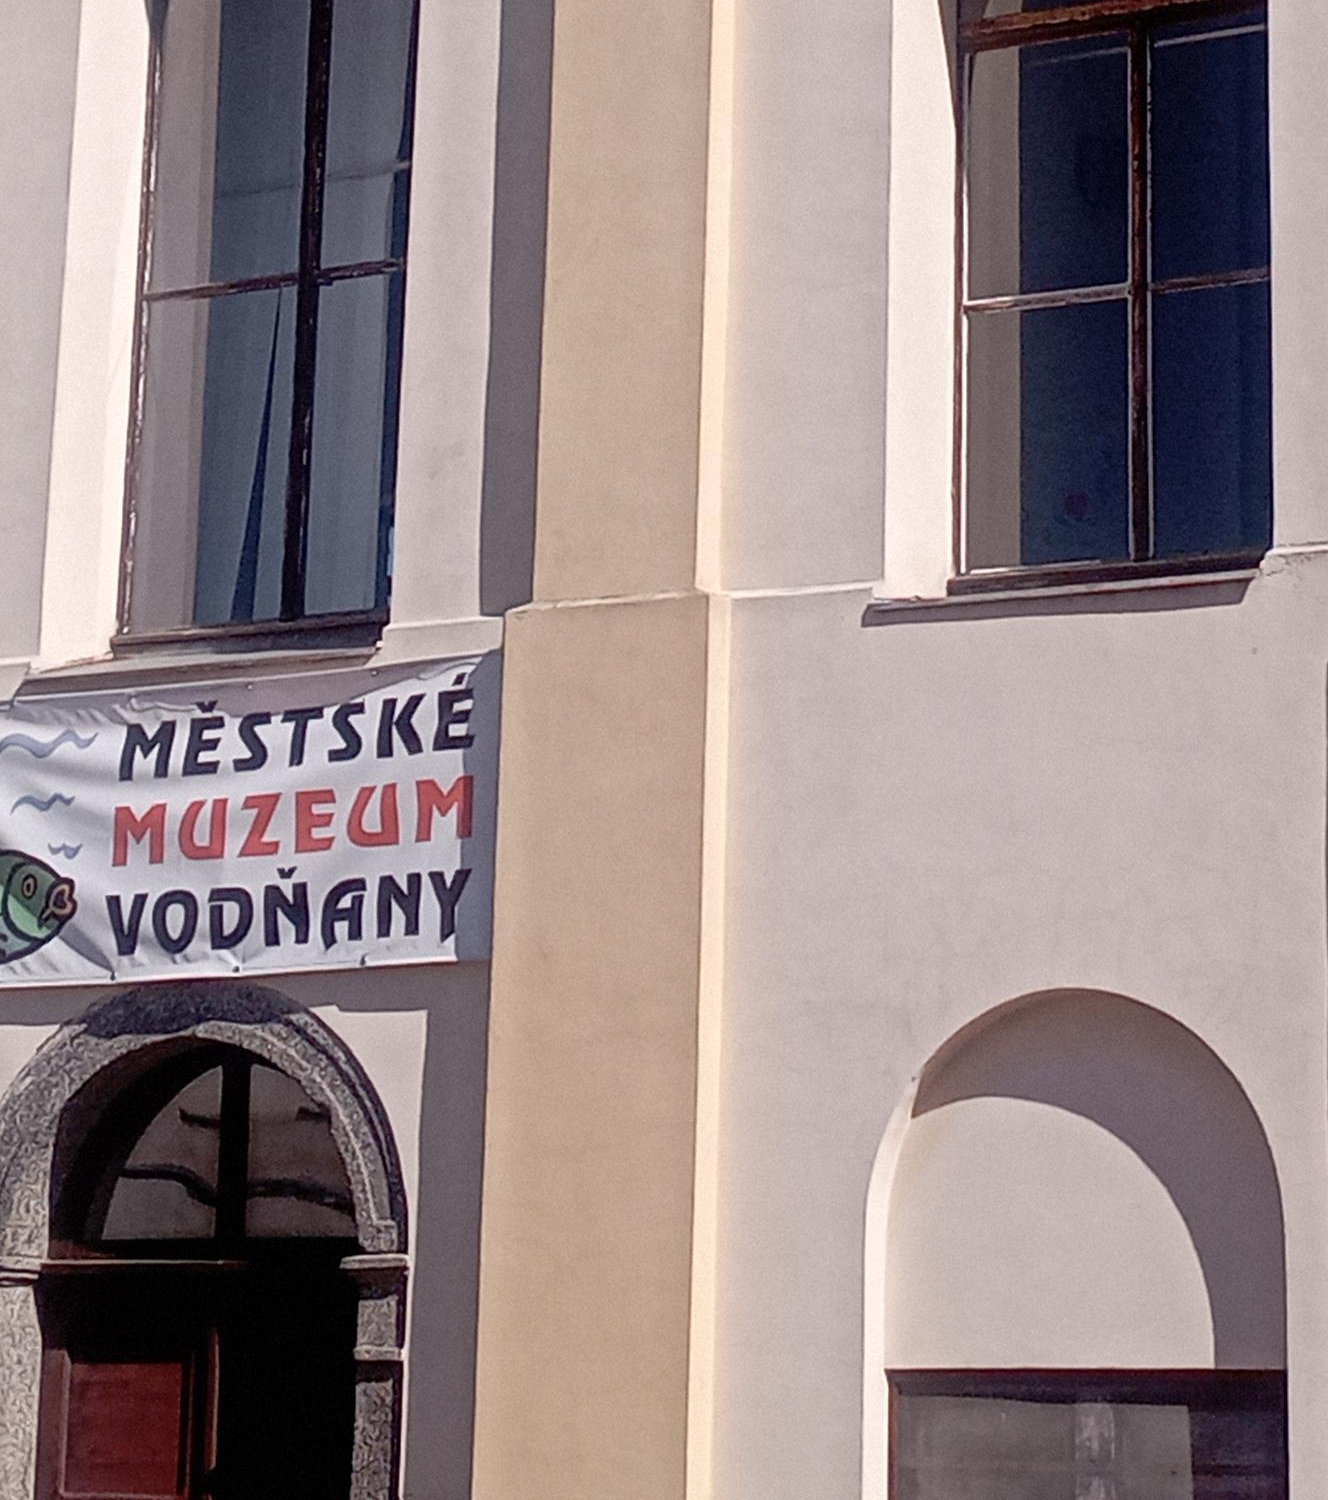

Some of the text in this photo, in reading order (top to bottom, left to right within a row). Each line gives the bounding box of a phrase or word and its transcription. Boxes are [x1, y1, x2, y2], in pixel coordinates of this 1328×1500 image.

[119, 673, 475, 782] MĚSTSKÉ
[112, 775, 474, 867] MUZEUM
[106, 866, 472, 956] VODŇANY
